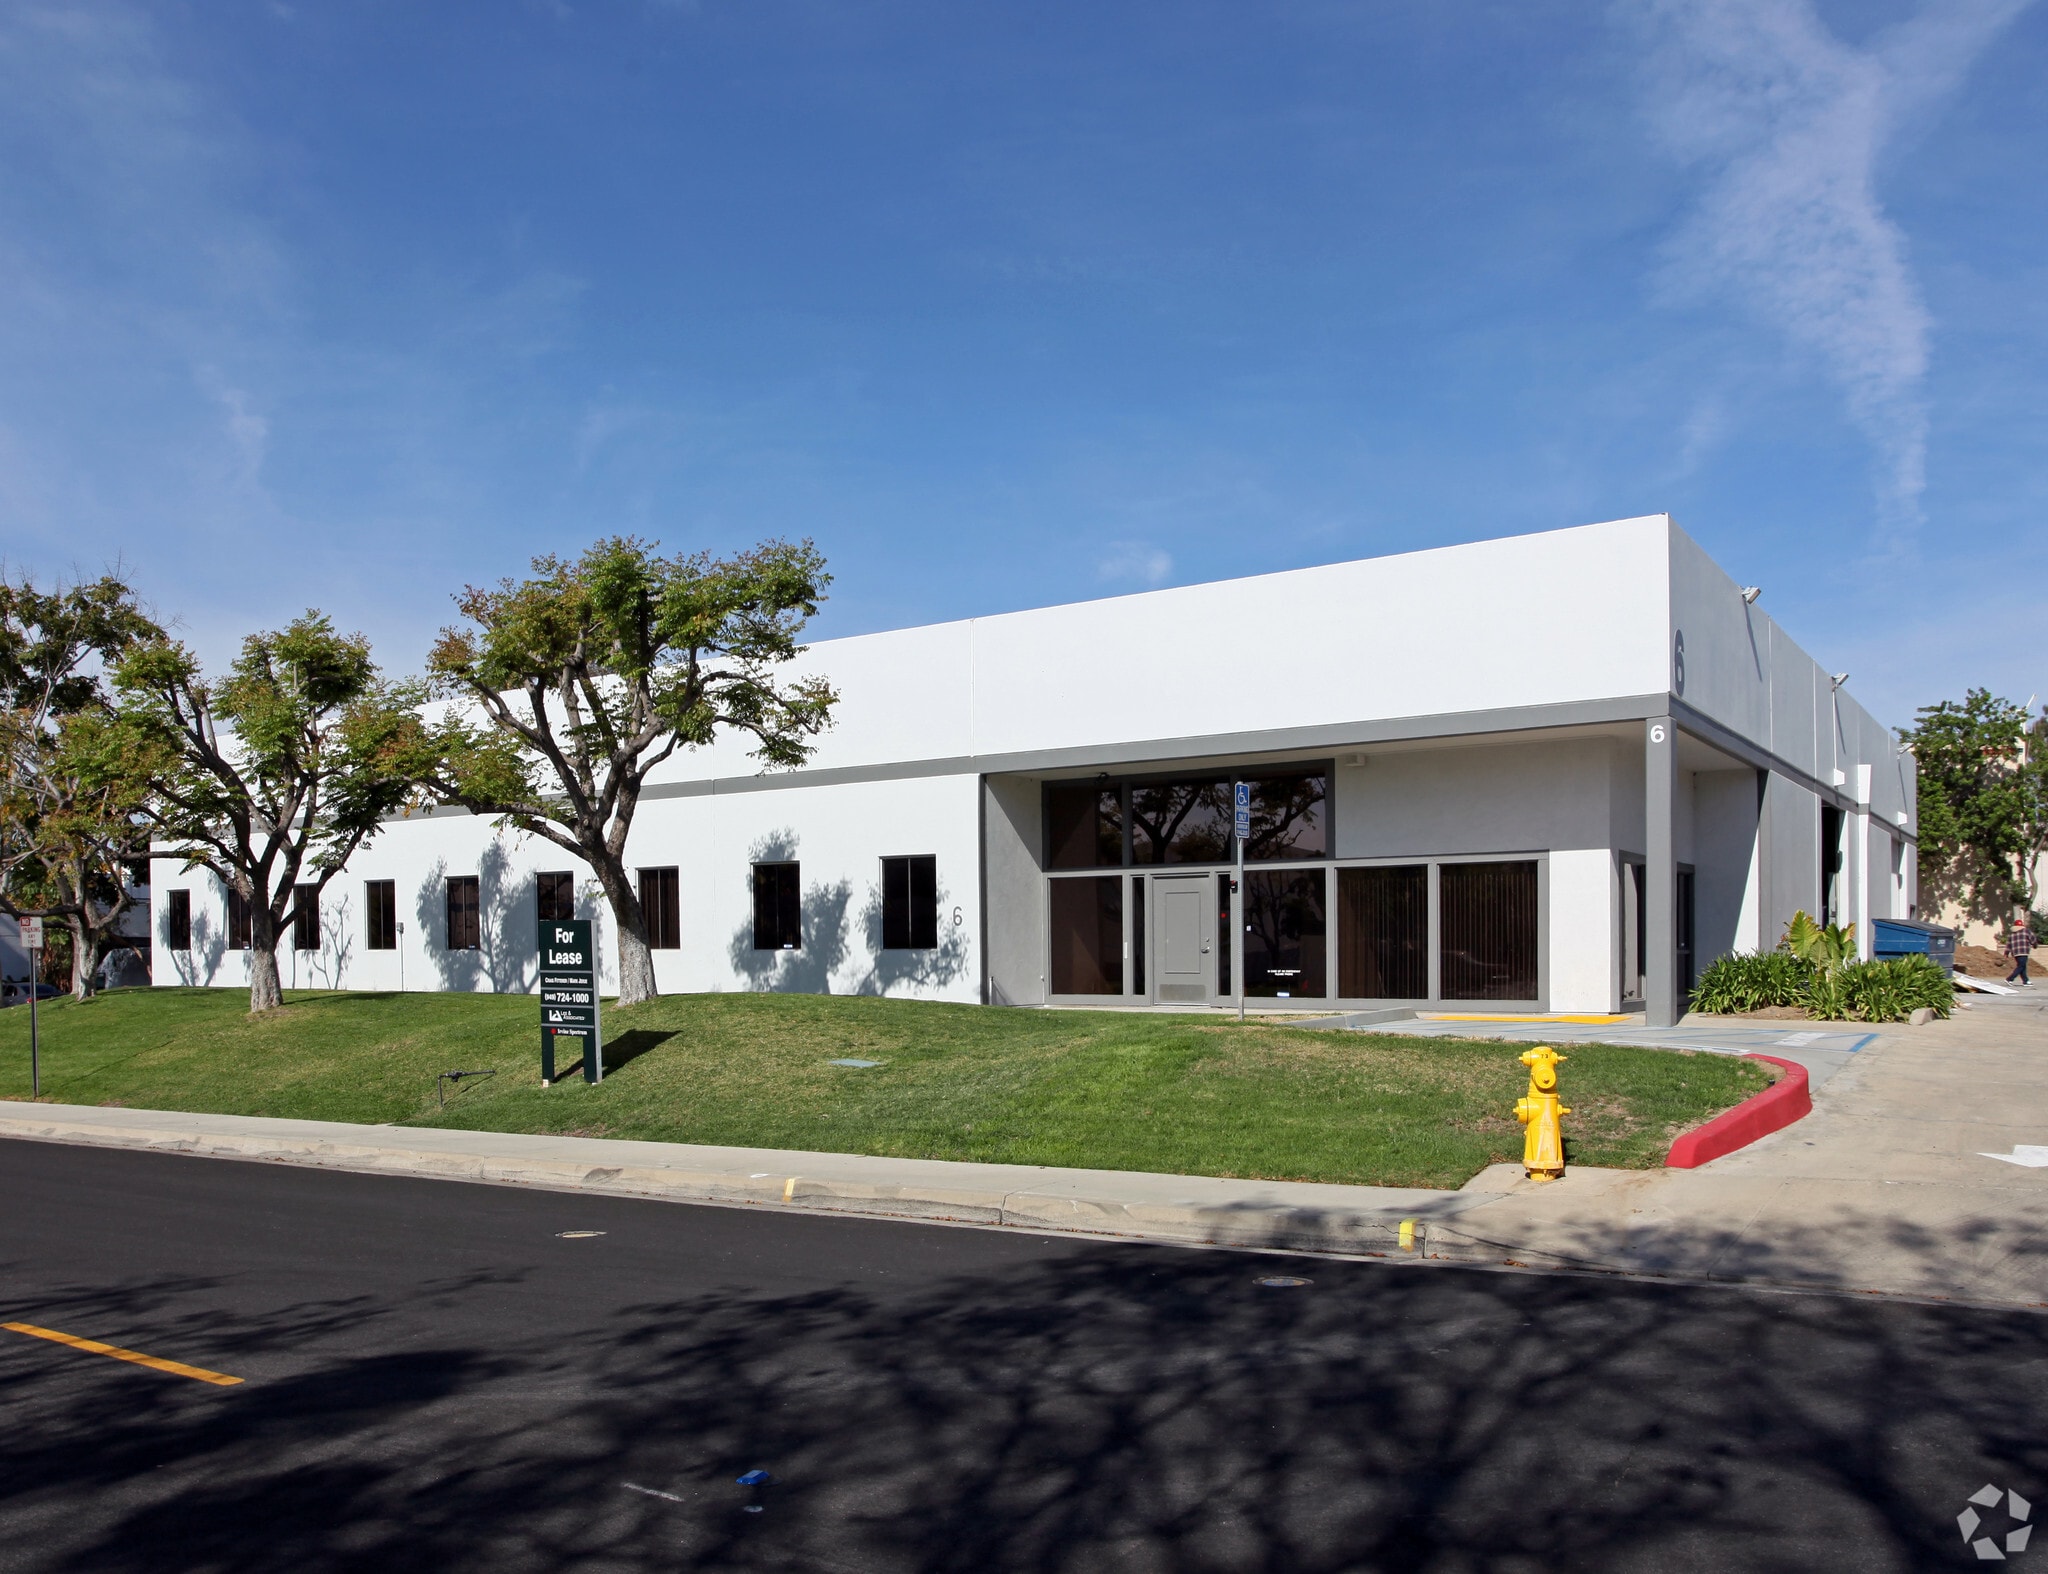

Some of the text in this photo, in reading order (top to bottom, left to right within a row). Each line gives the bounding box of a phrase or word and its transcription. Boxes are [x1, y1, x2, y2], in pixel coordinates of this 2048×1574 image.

[1674, 628, 1685, 699] 6
[1650, 724, 1665, 743] 6
[952, 905, 963, 927] 6
[555, 927, 575, 943] For
[549, 949, 582, 965] Lease
[556, 992, 590, 1003] 724-1000
